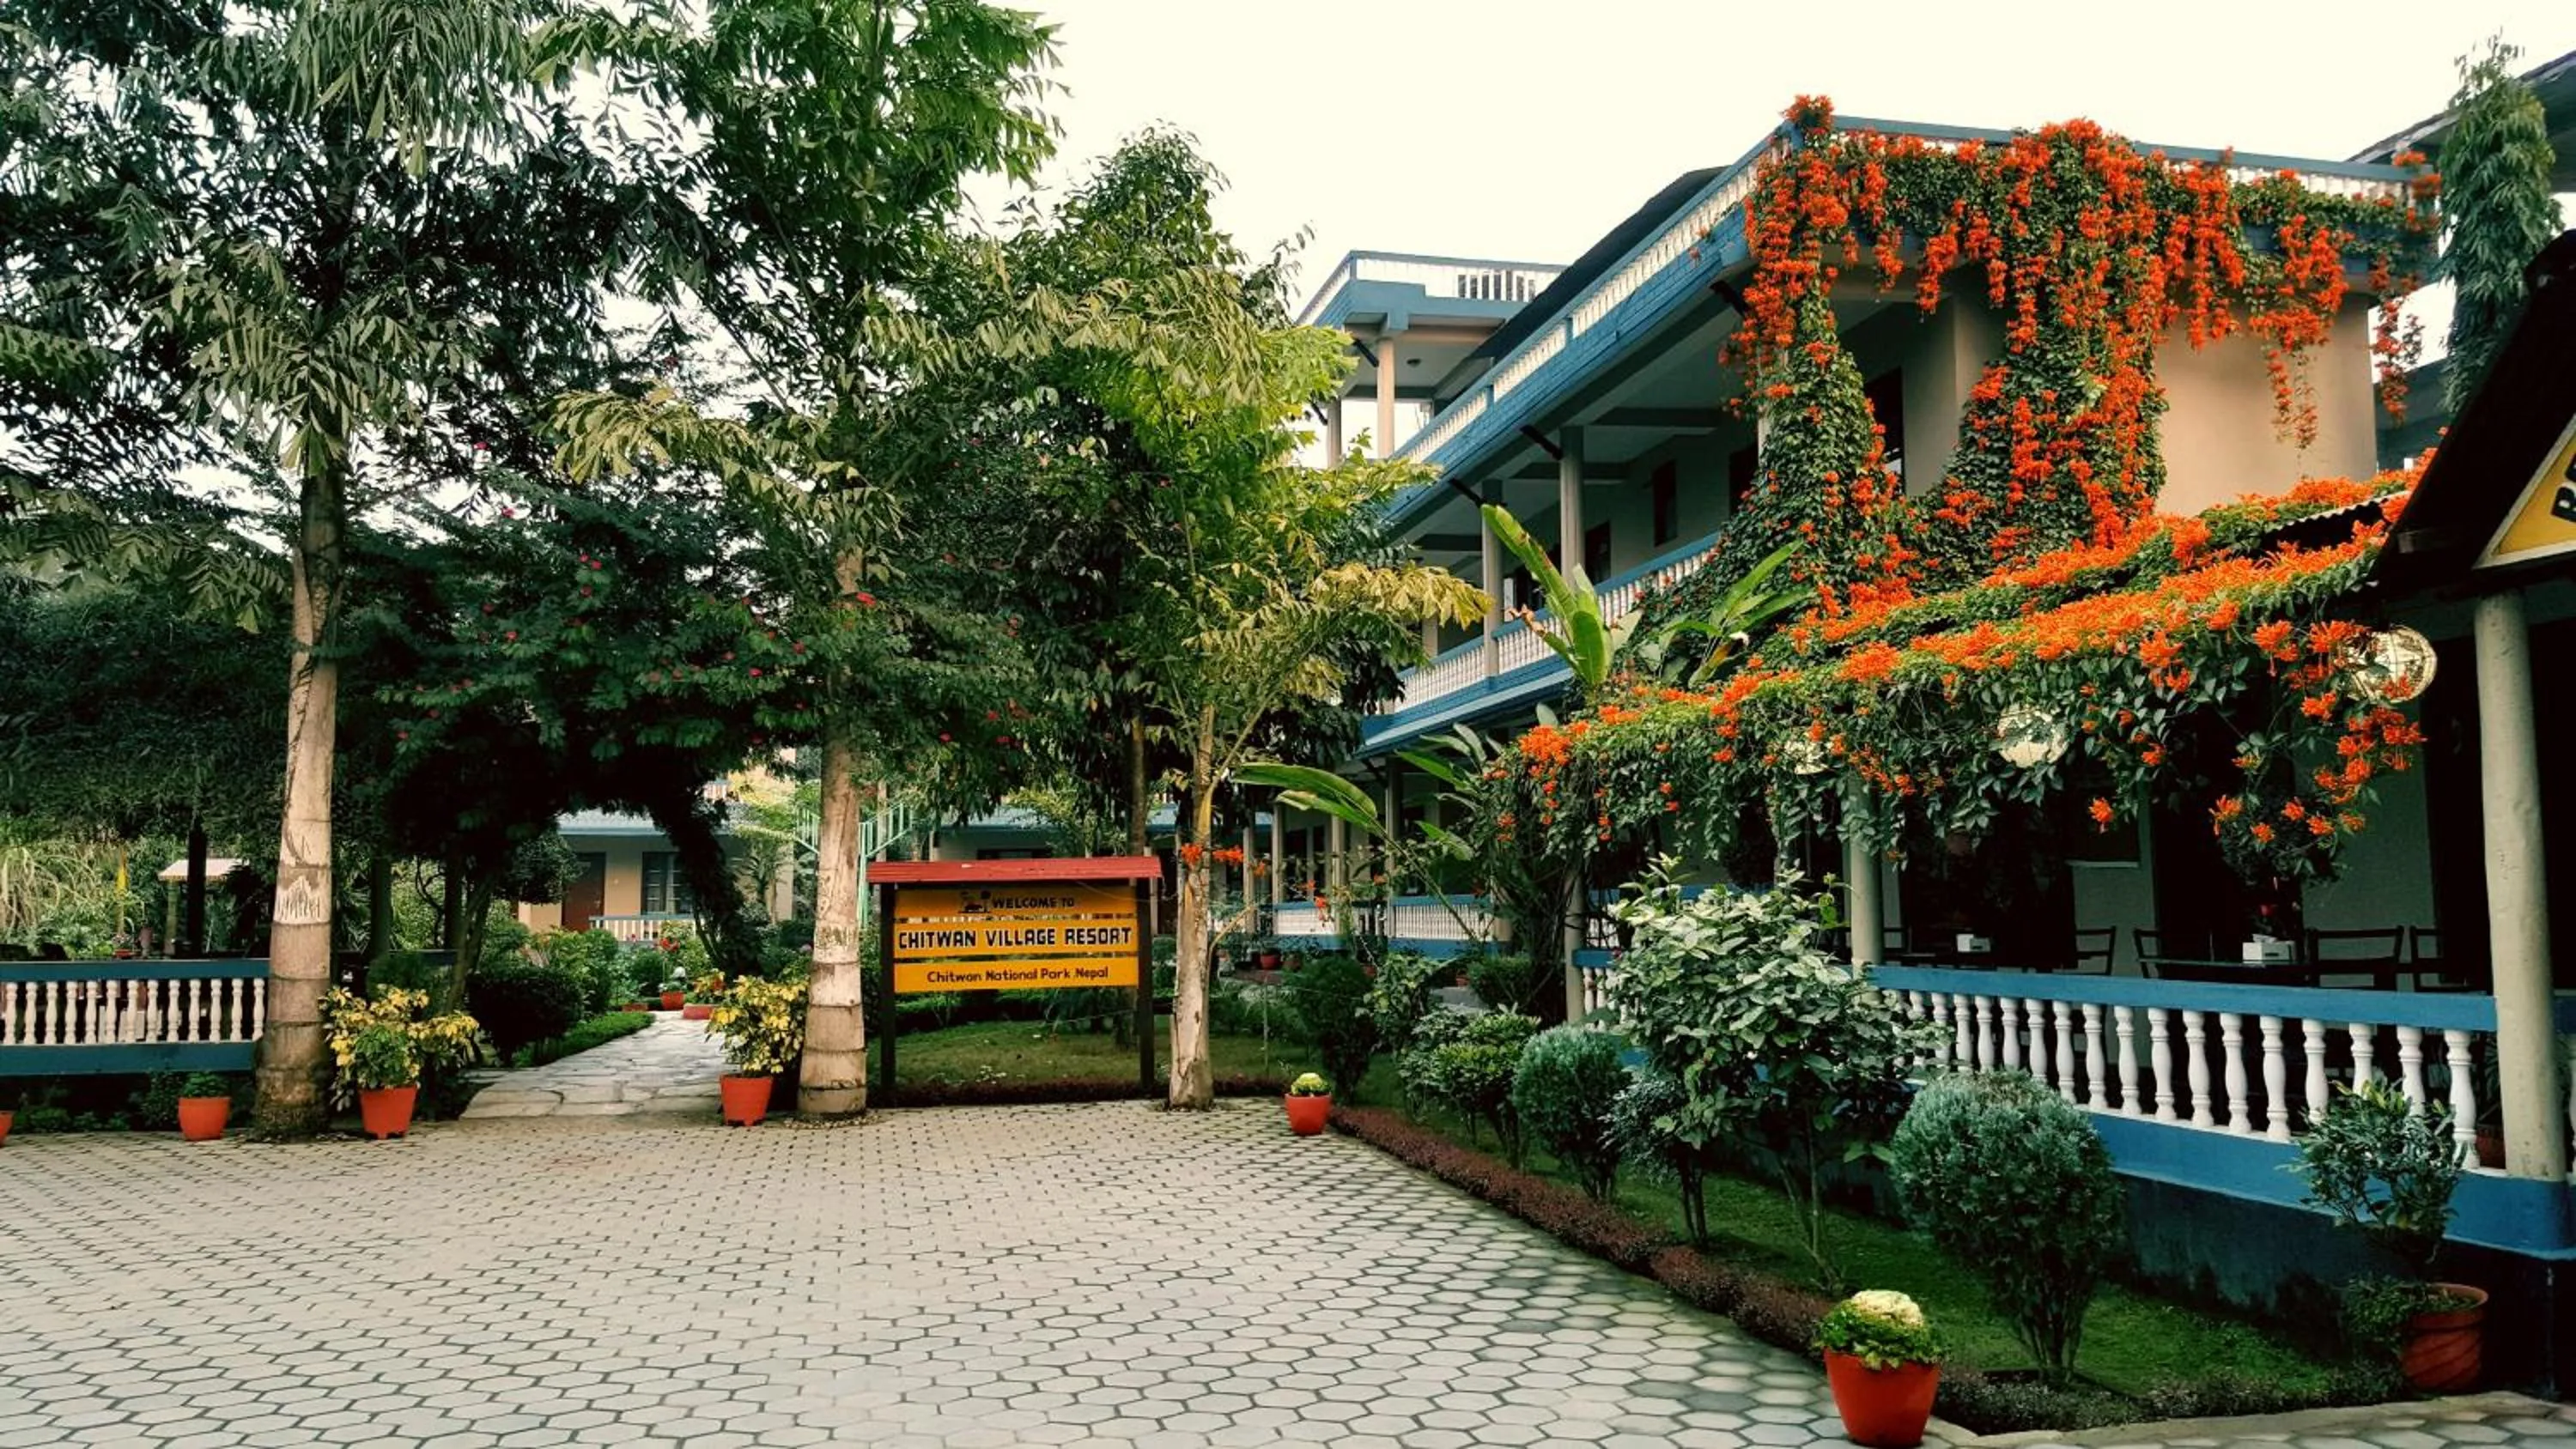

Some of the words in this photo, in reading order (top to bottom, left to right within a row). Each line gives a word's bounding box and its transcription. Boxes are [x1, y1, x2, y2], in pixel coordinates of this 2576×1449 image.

[992, 897, 1056, 909] WELCOME
[1061, 896, 1075, 908] TO
[898, 931, 976, 949] CHITWAN
[985, 928, 1056, 947] VILLAGE
[1065, 927, 1133, 945] RESORT
[927, 970, 982, 983] Chitwan
[985, 968, 1038, 981] National
[1040, 967, 1071, 980] Park
